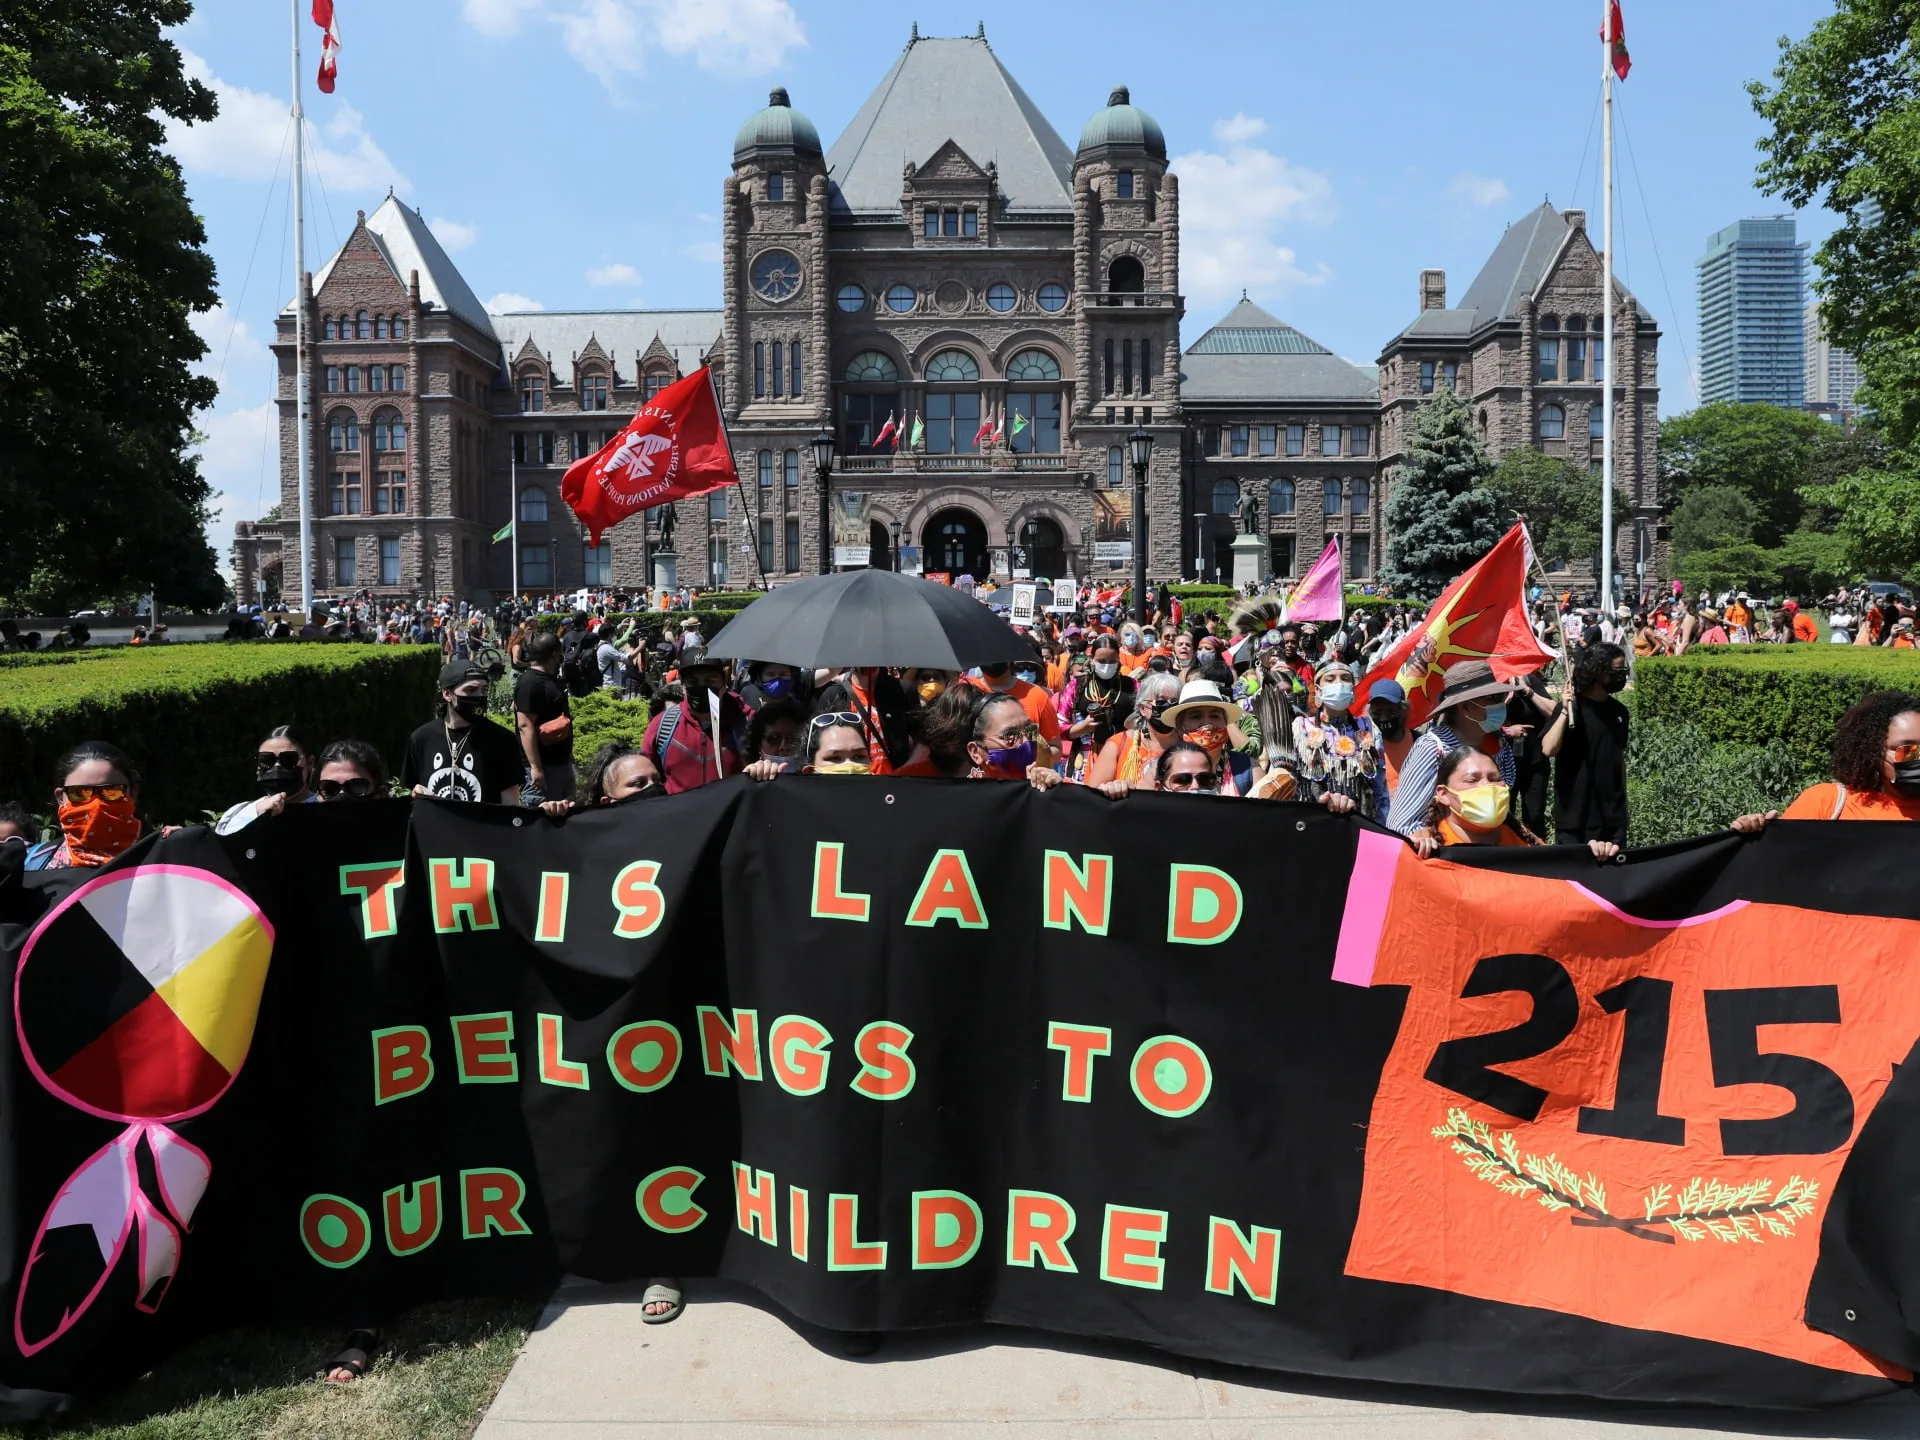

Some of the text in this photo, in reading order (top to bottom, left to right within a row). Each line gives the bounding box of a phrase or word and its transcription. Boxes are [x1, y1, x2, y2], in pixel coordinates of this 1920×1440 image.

[340, 842, 1243, 945] THIS LAND
[371, 1005, 1212, 1118] BELONGS TO
[1424, 953, 1854, 1155] 215
[300, 1161, 1281, 1304] OUR CHILDREN
